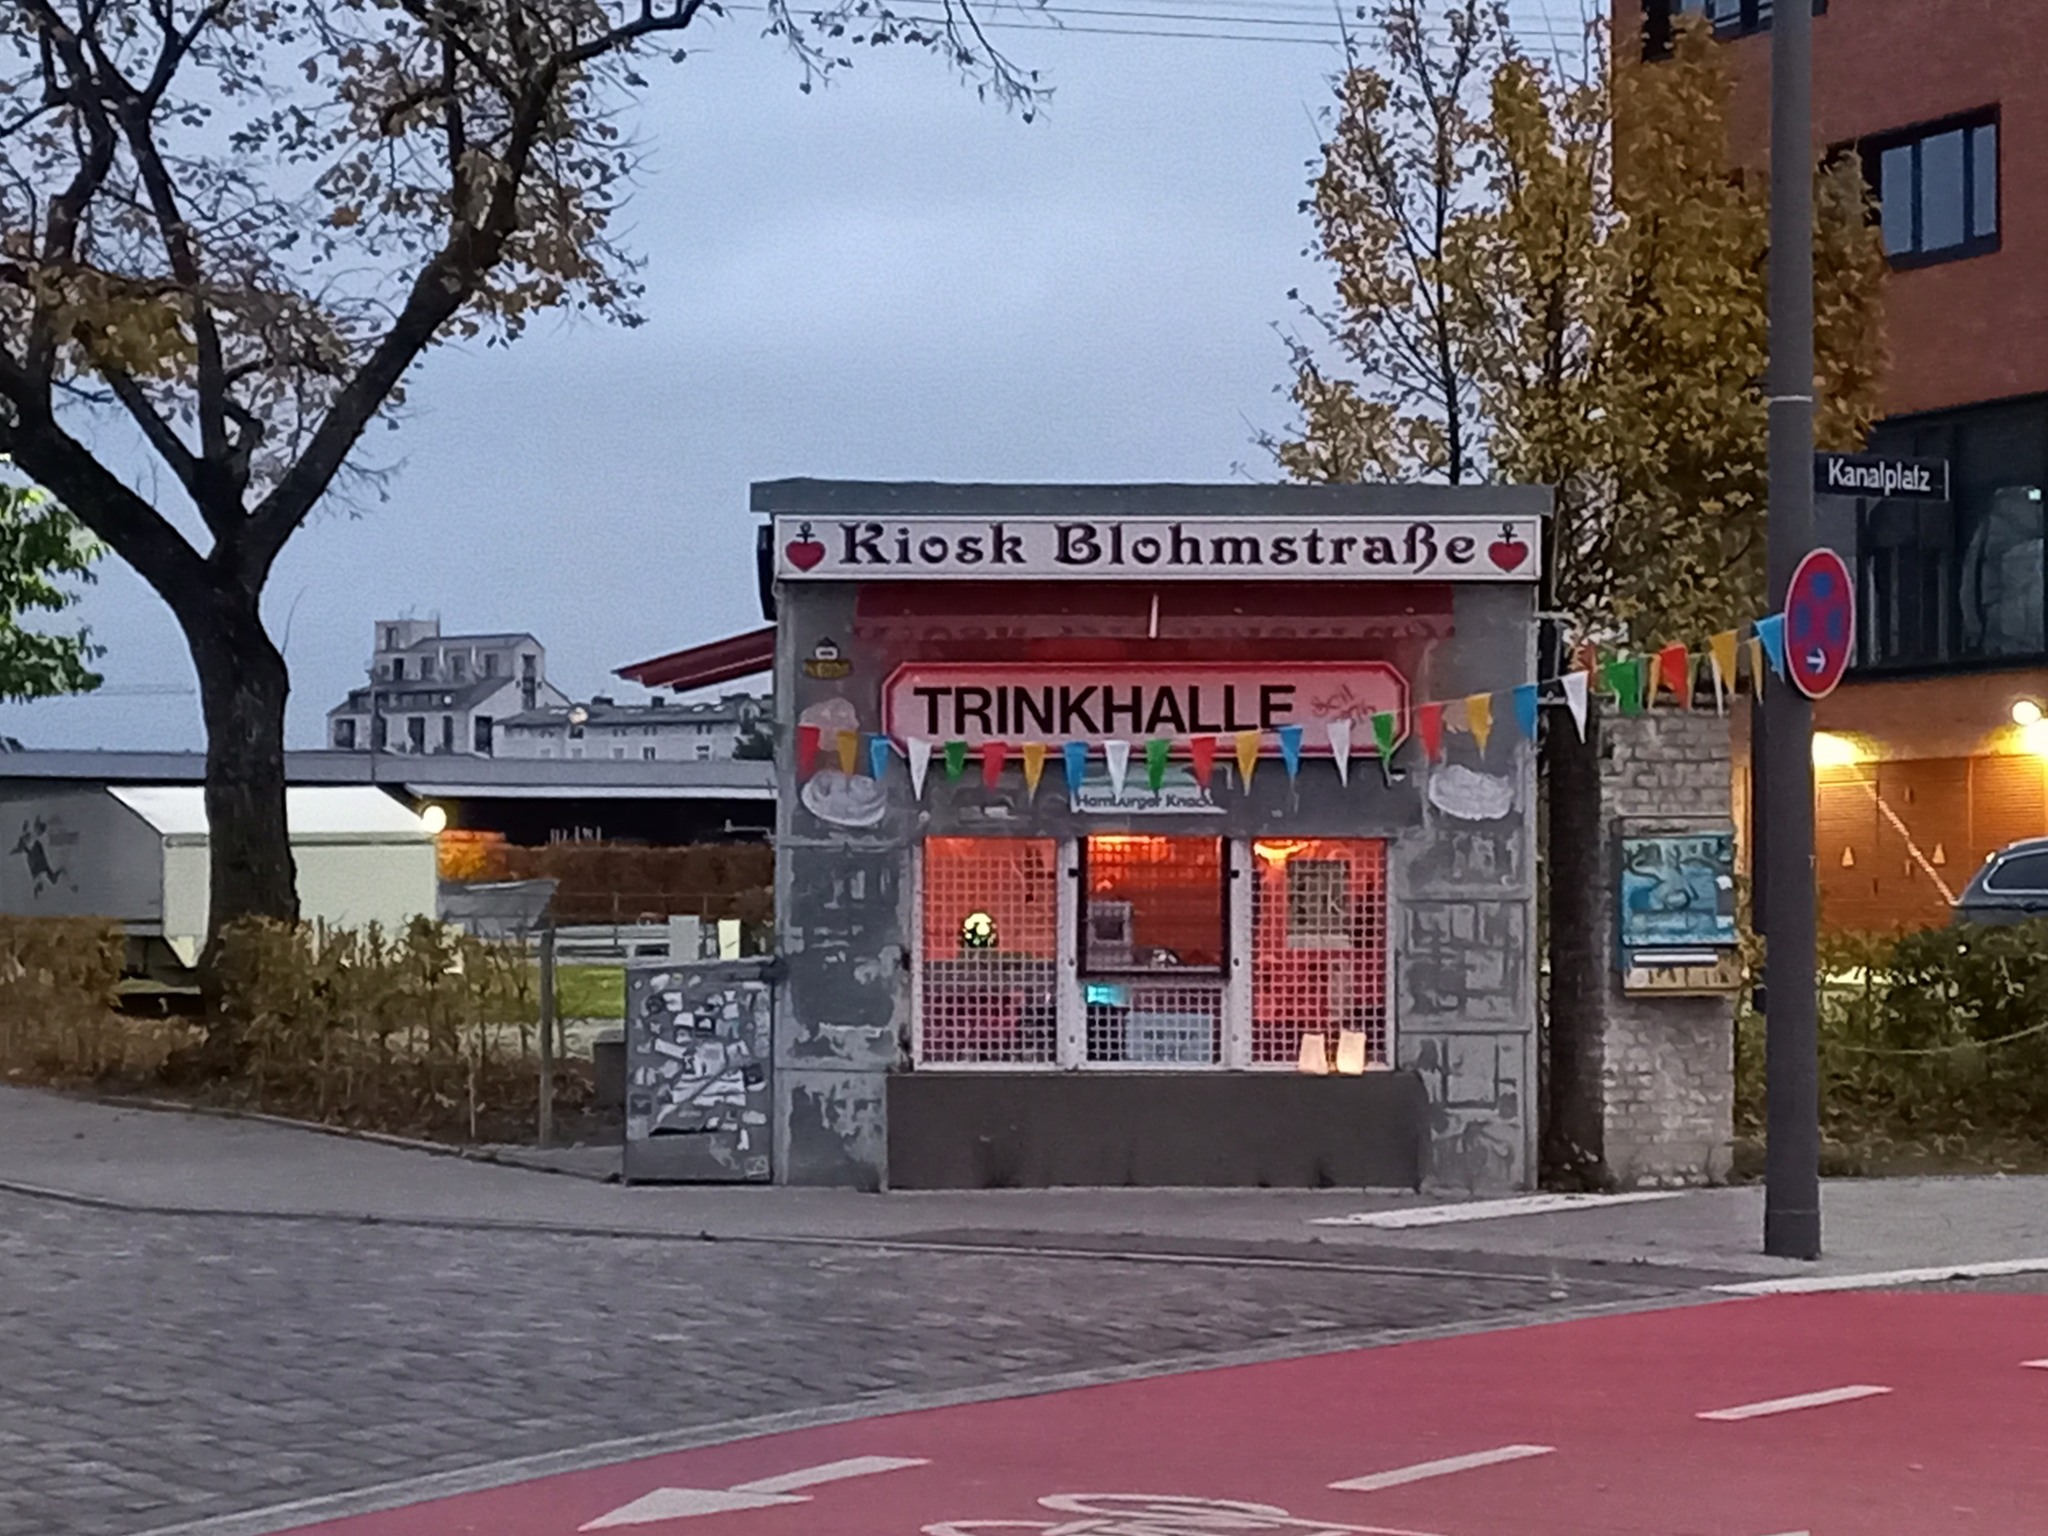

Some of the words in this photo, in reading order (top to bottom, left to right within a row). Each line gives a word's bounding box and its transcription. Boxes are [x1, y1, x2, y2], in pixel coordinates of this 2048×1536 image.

[1828, 457, 1931, 496] Kanalplatz
[838, 521, 1027, 565] Kiosk
[1053, 521, 1476, 574] Blohmstraße
[913, 685, 1297, 735] TRINKHALLE
